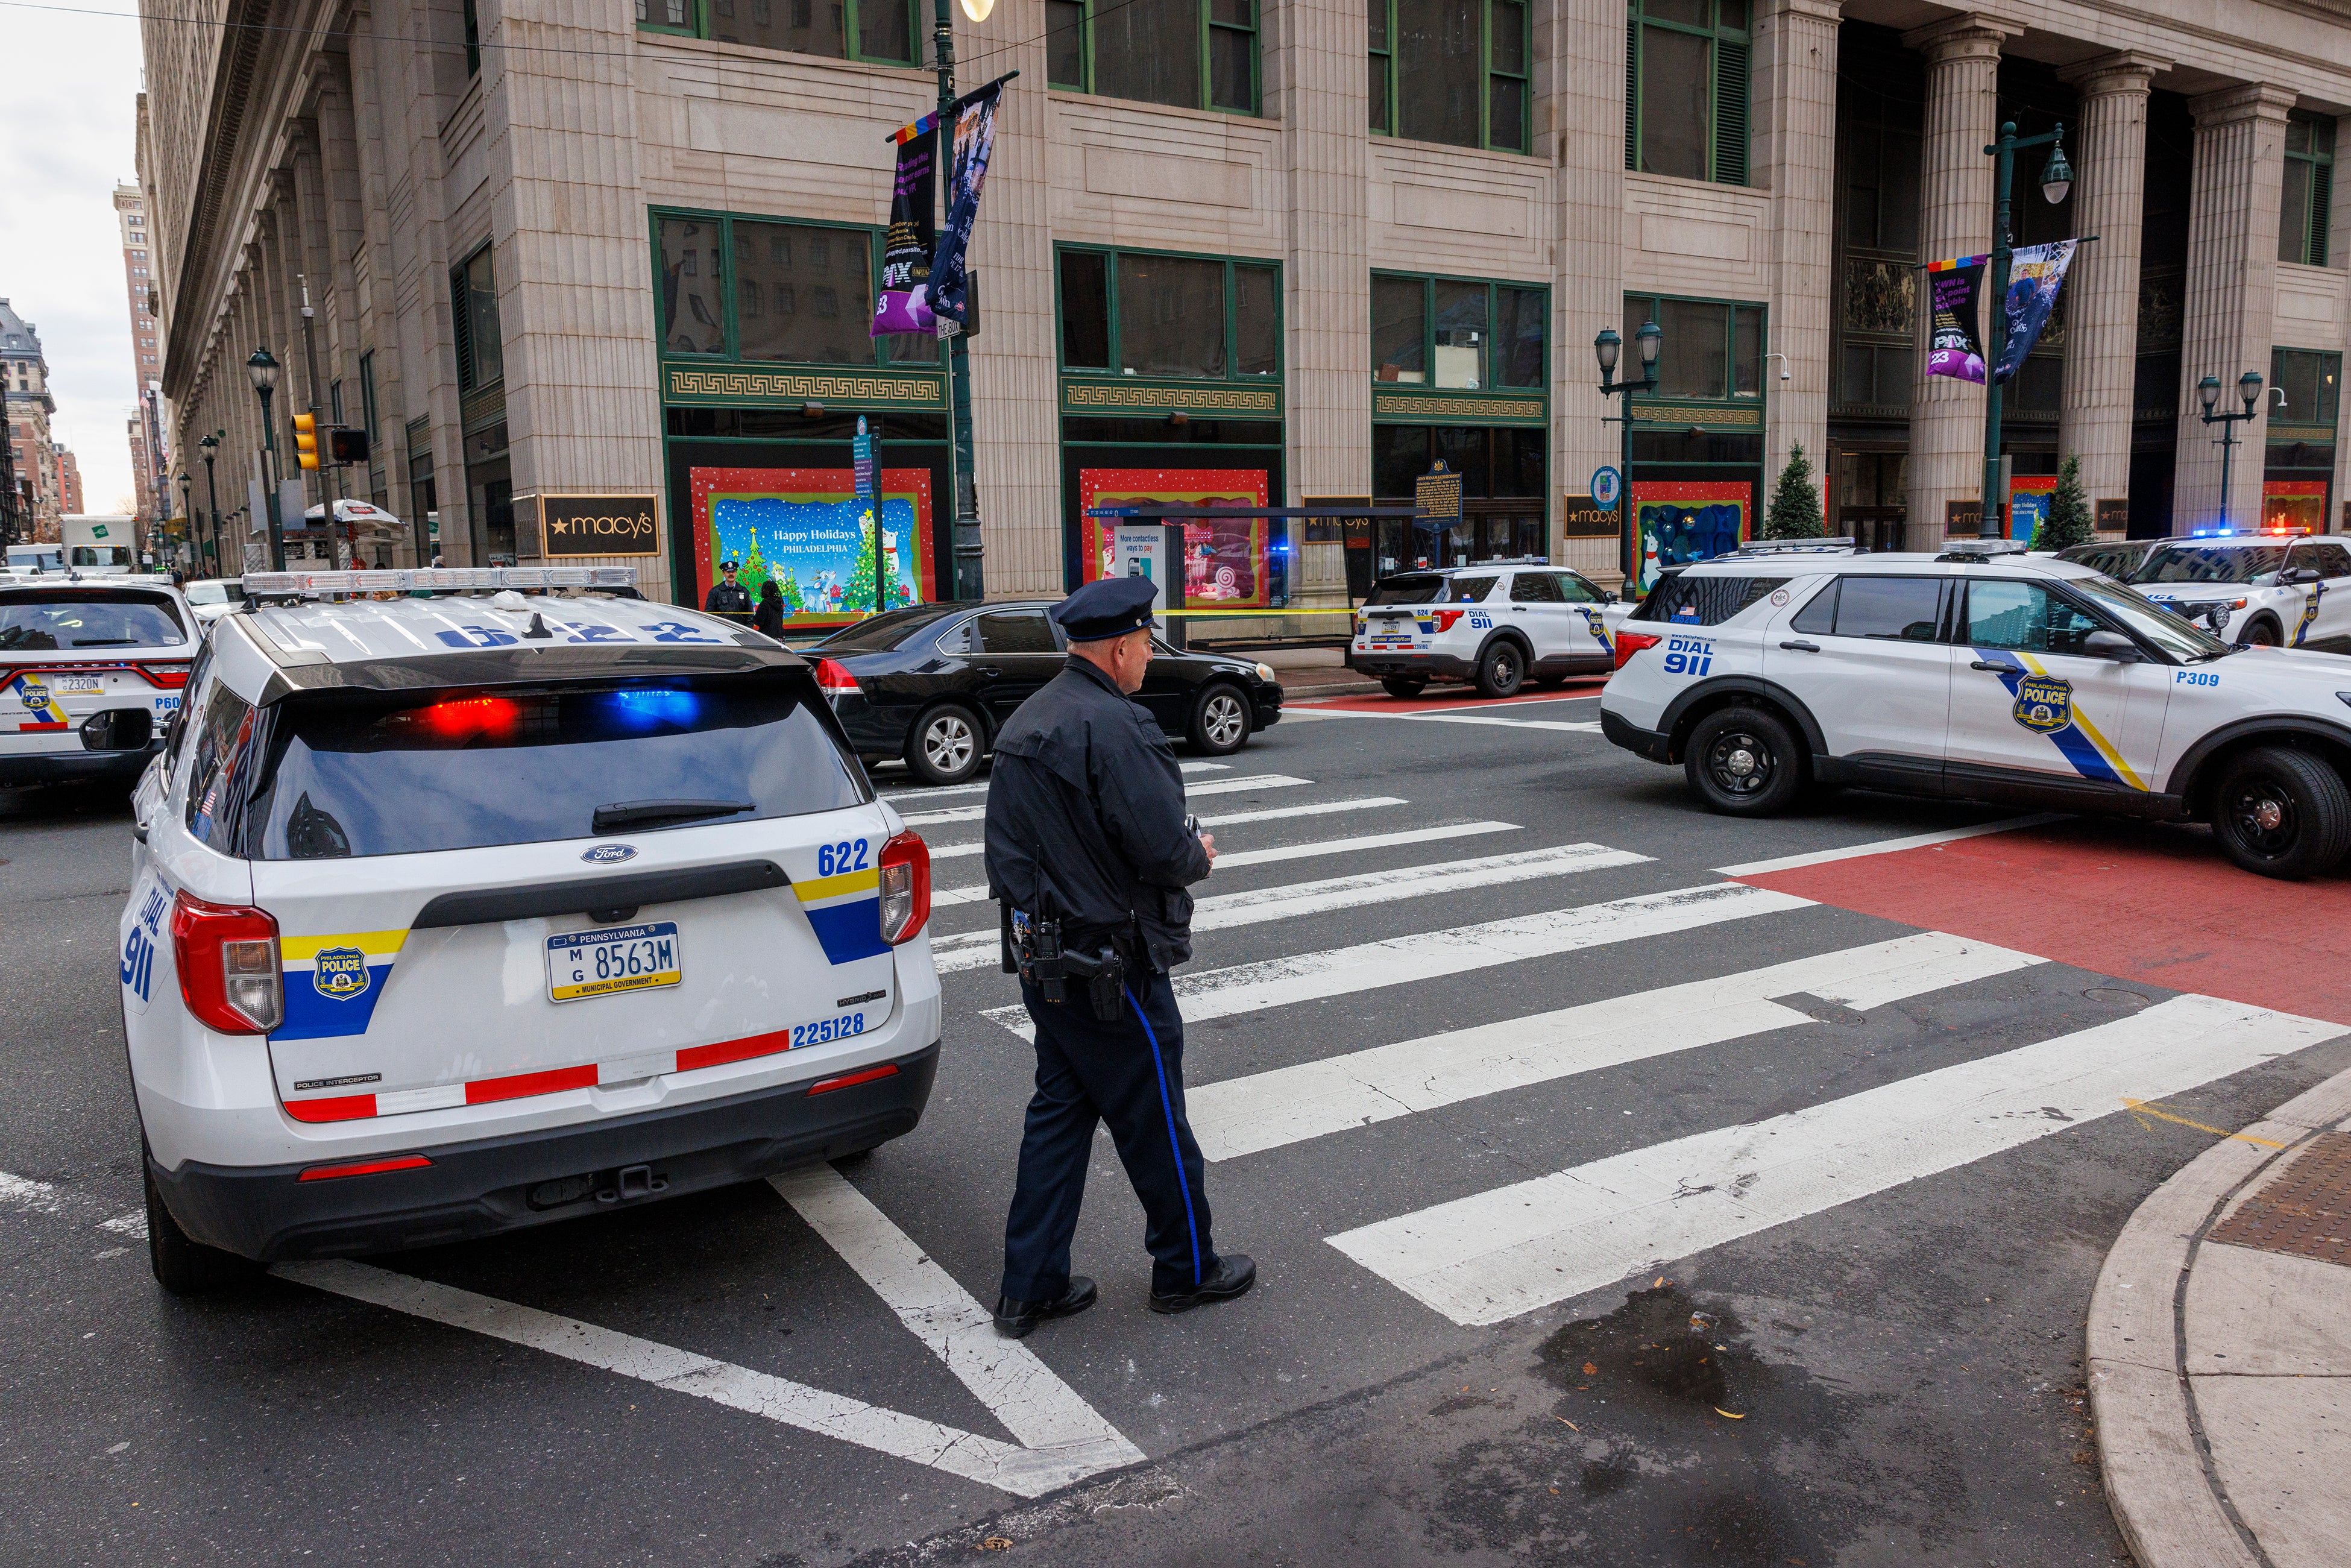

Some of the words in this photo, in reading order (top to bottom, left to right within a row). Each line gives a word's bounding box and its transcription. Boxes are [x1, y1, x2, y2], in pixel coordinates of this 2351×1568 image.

[898, 158, 917, 171] Rading
[895, 172, 914, 184] baner
[914, 166, 930, 178] earns
[953, 252, 965, 264] FDR
[1957, 278, 1965, 286] is
[949, 320, 958, 333] BOX
[1934, 335, 1968, 350] PAX
[1930, 351, 1949, 365] 23
[774, 530, 808, 542] Happy
[811, 529, 856, 541] Holidays
[1132, 534, 1159, 543] contactless
[784, 544, 848, 553] PHILADELPHIA
[1126, 544, 1138, 553] ways
[1471, 618, 1493, 629] 911
[1669, 614, 1701, 625] 235206
[1672, 634, 1717, 642] www.PhillyPolice.com
[1668, 639, 1714, 655] DIAL
[1664, 653, 1712, 676] 911
[69, 678, 98, 690] 2320N
[2176, 672, 2220, 687] P309
[2025, 682, 2068, 691] PHILADELPHIA
[2024, 688, 2066, 705] POLICE
[594, 846, 625, 859] Ford
[818, 838, 868, 877] 622
[140, 886, 167, 937] DIAL
[580, 929, 646, 943] PENNSYLVANIA
[570, 949, 582, 961] M
[596, 939, 673, 979] 8563M
[121, 926, 154, 1003] 911
[322, 959, 360, 972] POLICE
[573, 969, 584, 981] G
[582, 981, 612, 993] MUNICIPAL
[614, 977, 652, 989] GOVERNMENT
[839, 995, 866, 1006] HYBRID
[793, 1013, 864, 1048] 225128
[326, 1074, 379, 1085] INTERCEPTOR
